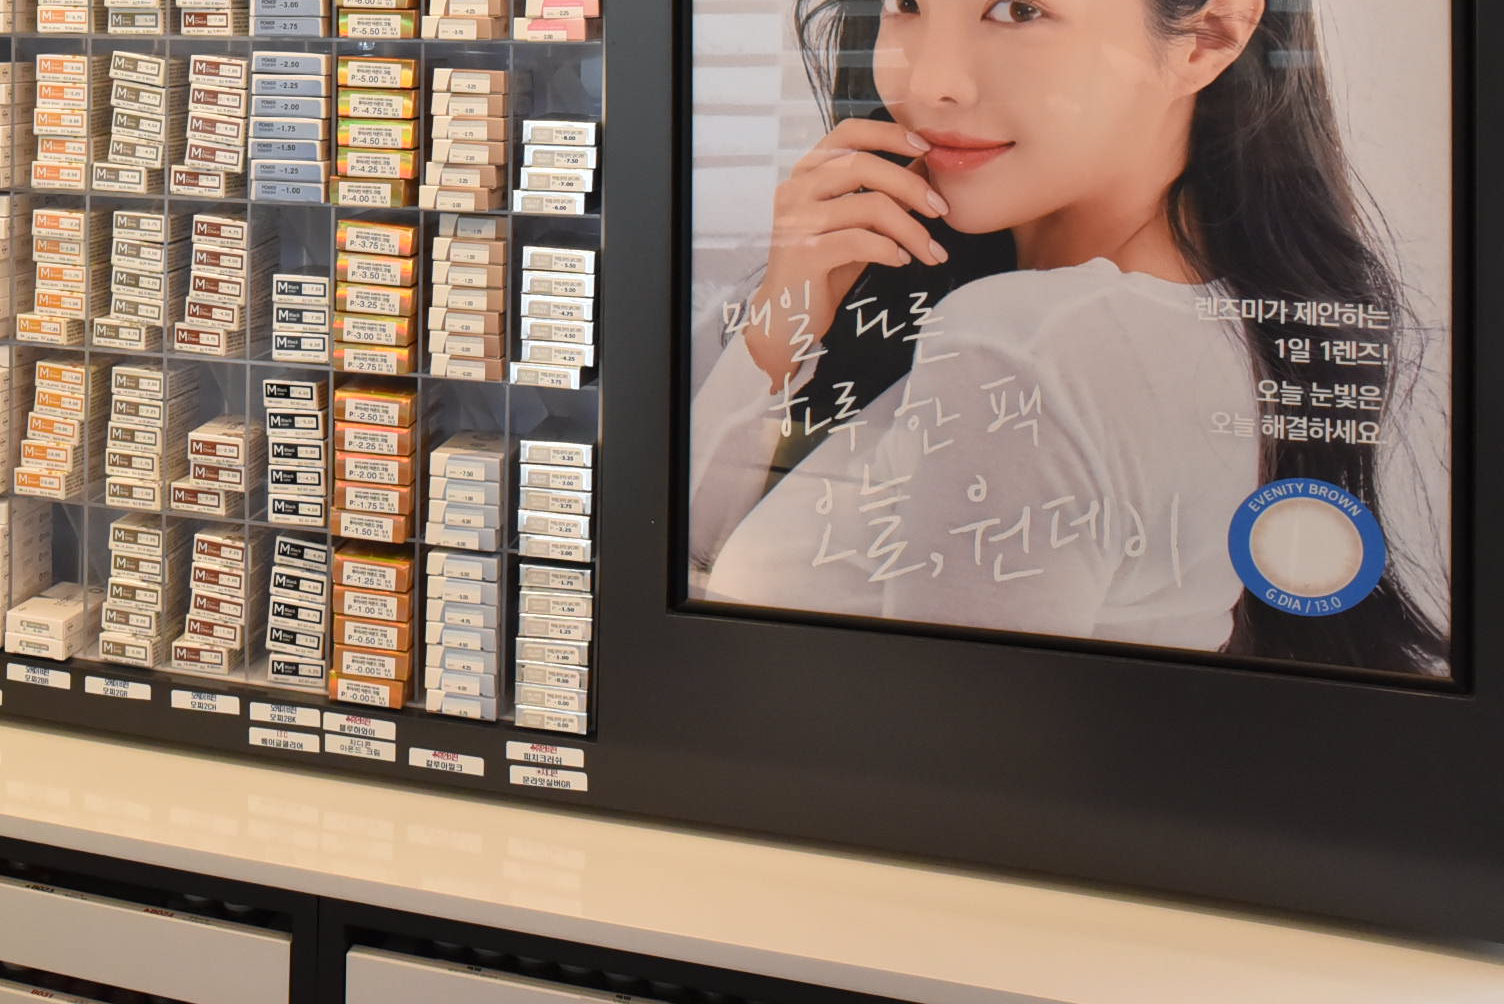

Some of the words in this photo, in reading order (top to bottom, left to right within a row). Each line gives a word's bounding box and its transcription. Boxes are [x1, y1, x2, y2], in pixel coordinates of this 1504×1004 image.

[721, 280, 827, 363] 매일
[846, 292, 961, 369] 다른
[1195, 297, 1287, 324] 렌즈미가
[1294, 302, 1389, 329] 제안하는
[1274, 337, 1310, 365] 1일
[1321, 339, 1389, 368] 1렌즈!
[1257, 379, 1300, 406] 오늘
[1310, 381, 1381, 410] 눈빛은
[770, 374, 869, 450] 하루
[896, 385, 961, 450] 한
[980, 378, 1043, 447] 팩
[1210, 410, 1254, 437] 오늘
[1248, 481, 1305, 515] EVENITY
[1307, 482, 1362, 519] BROWN
[948, 475, 1184, 588] 원데이
[1263, 587, 1302, 612] G.DIA
[1313, 594, 1342, 614] 13.0
[524, 753, 562, 764] 피치크러쉬
